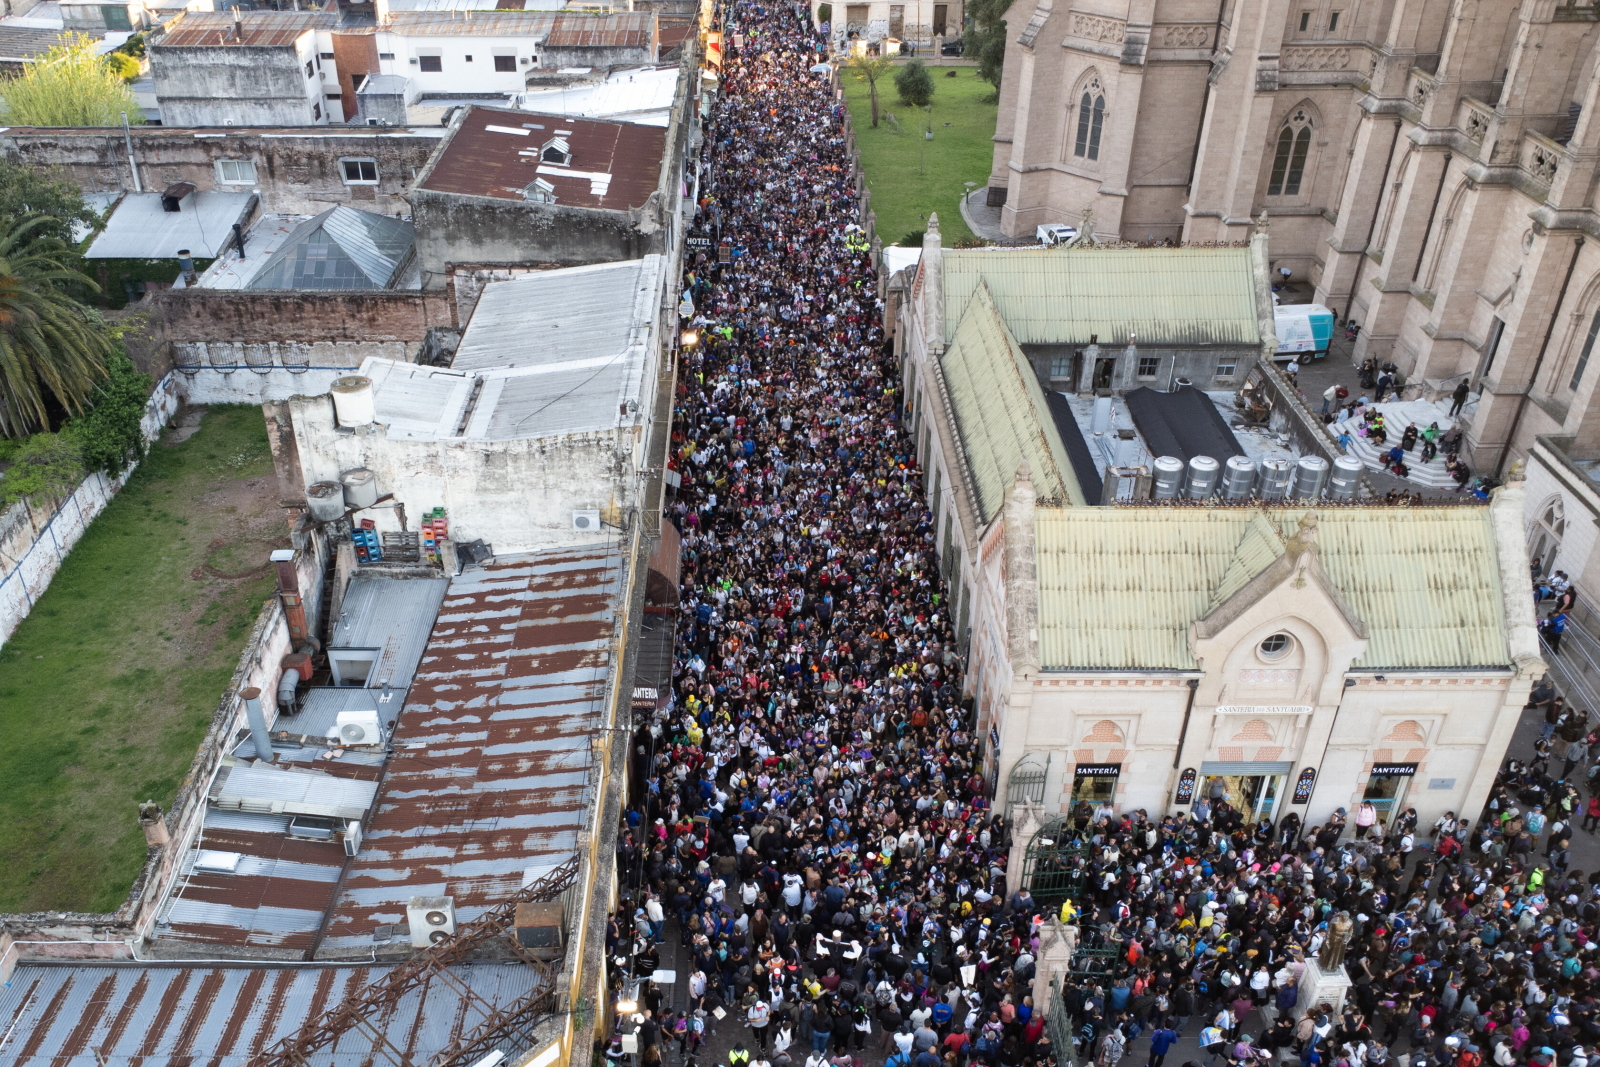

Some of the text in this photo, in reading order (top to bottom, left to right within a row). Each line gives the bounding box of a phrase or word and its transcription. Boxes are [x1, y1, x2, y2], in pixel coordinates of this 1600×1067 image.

[687, 237, 711, 246] HOTEL
[632, 687, 658, 699] ANTERIA
[1076, 766, 1118, 775] SANTERÍA
[1371, 766, 1414, 774] SANTERÍA
